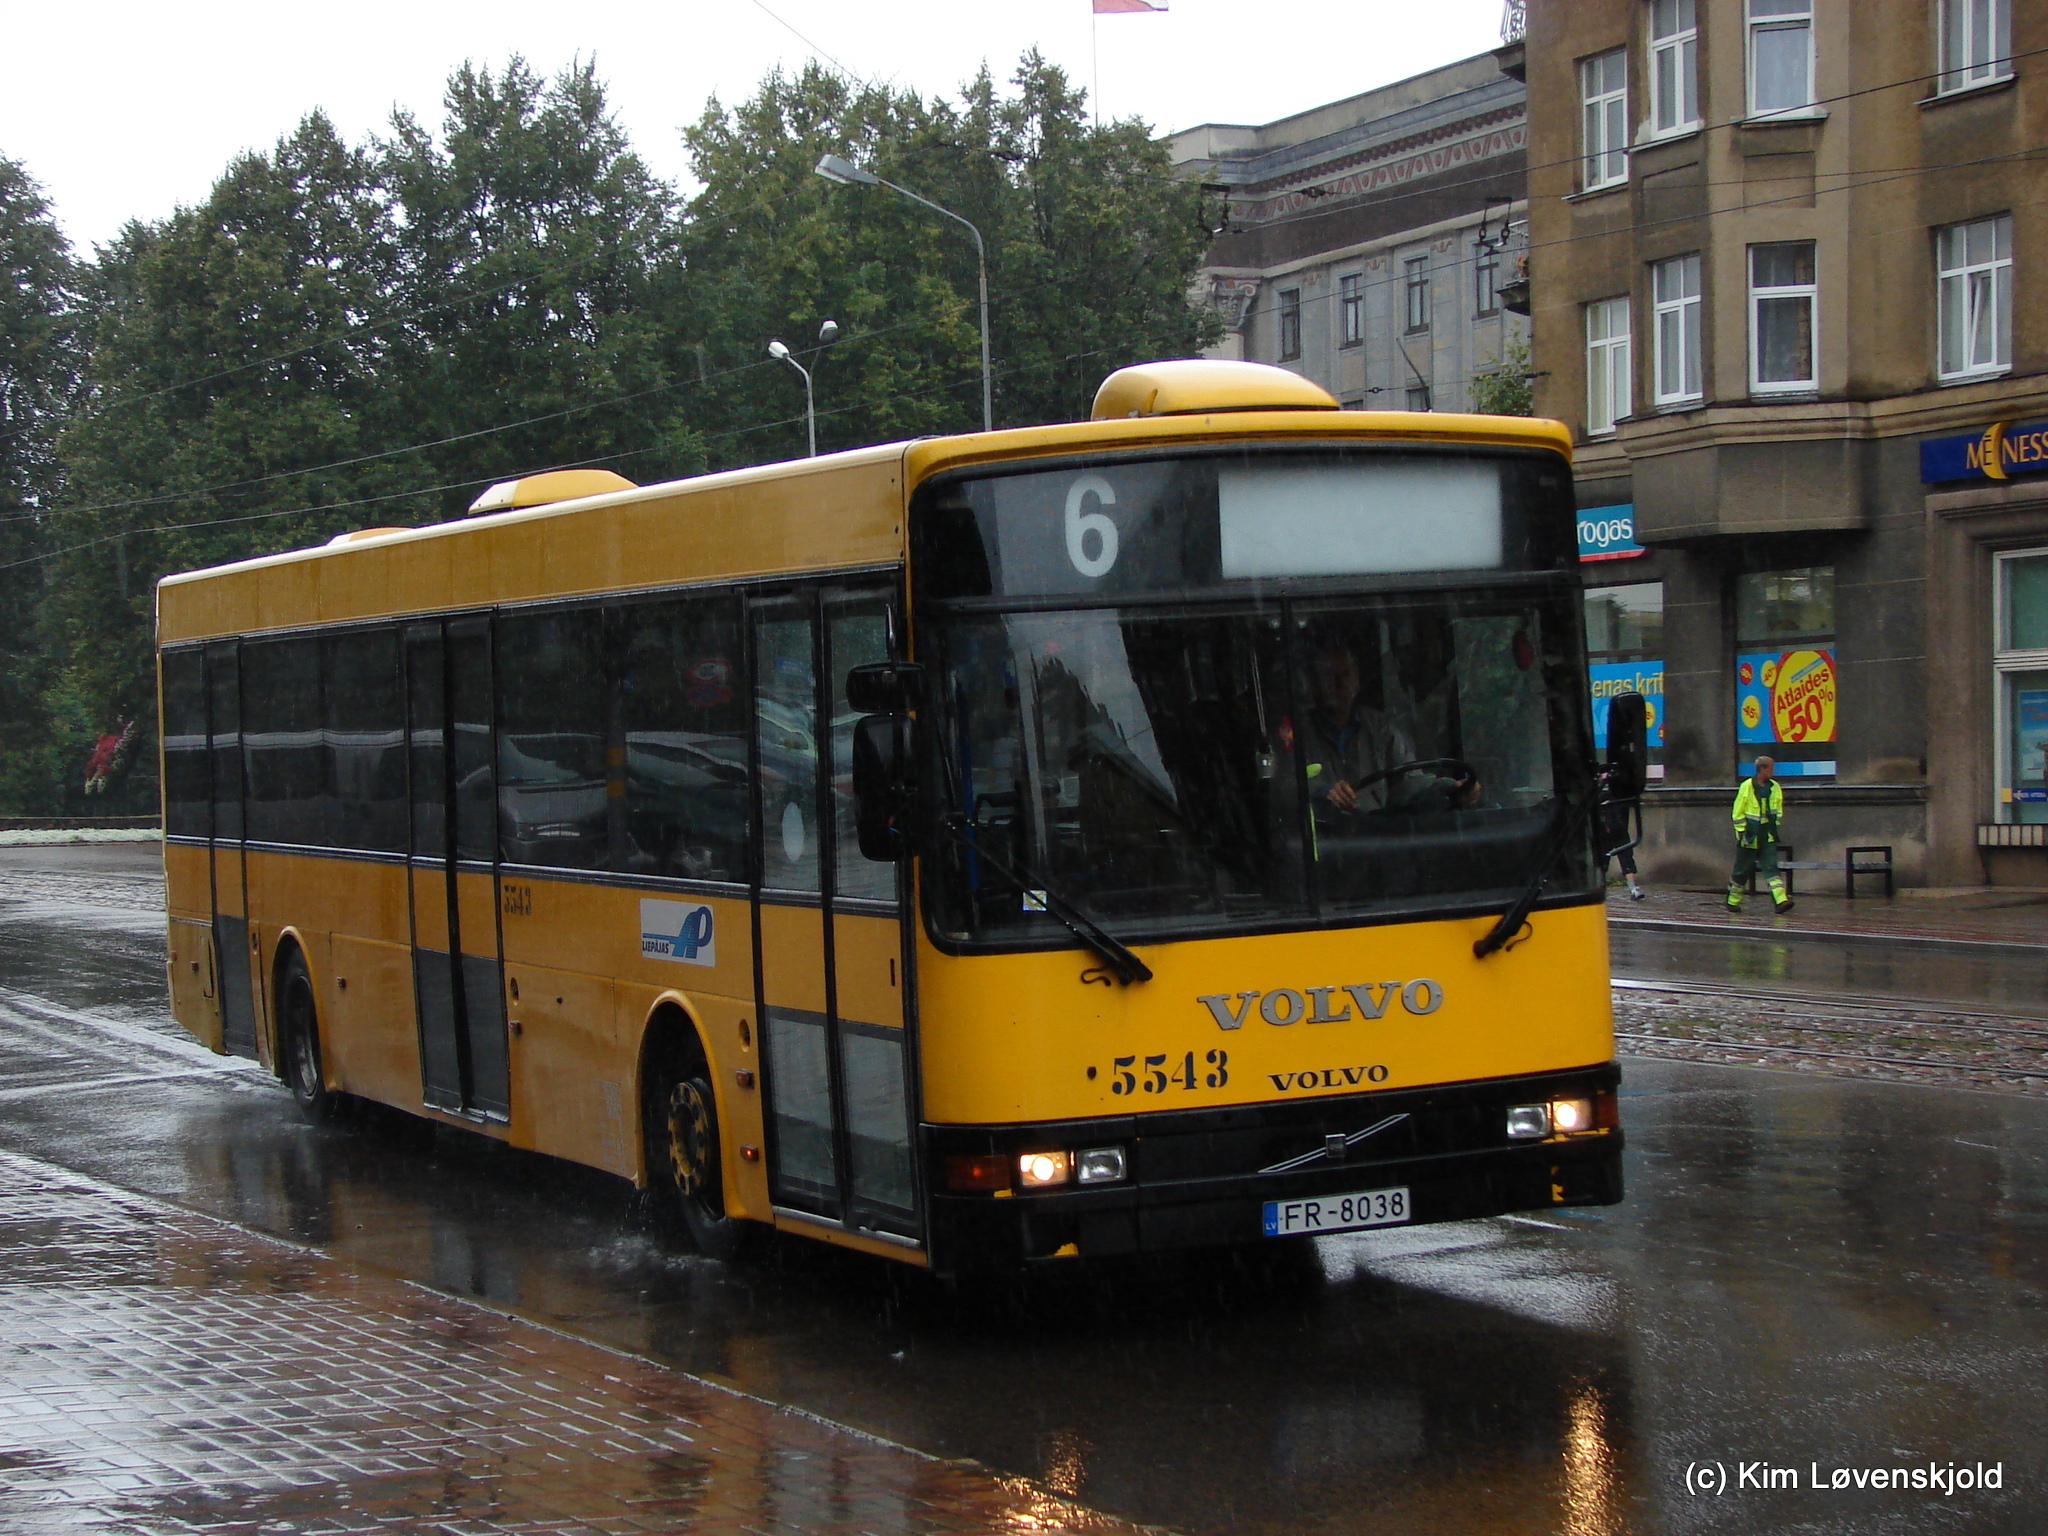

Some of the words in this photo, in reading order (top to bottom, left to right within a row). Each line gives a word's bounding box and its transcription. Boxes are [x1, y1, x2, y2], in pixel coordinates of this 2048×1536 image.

[1065, 474, 1119, 578] 6
[1576, 518, 1633, 548] rogas
[1590, 678, 1633, 698] enas
[1777, 668, 1829, 714] Atlaides
[504, 885, 532, 916] 5543
[642, 939, 669, 954] LIEPĀJAS
[1197, 977, 1443, 1031] VOLVO
[1112, 1049, 1229, 1096] 5543
[1267, 1064, 1389, 1092] VOLVO
[1265, 1221, 1277, 1230] LV
[1285, 1192, 1404, 1230] FR-8038
